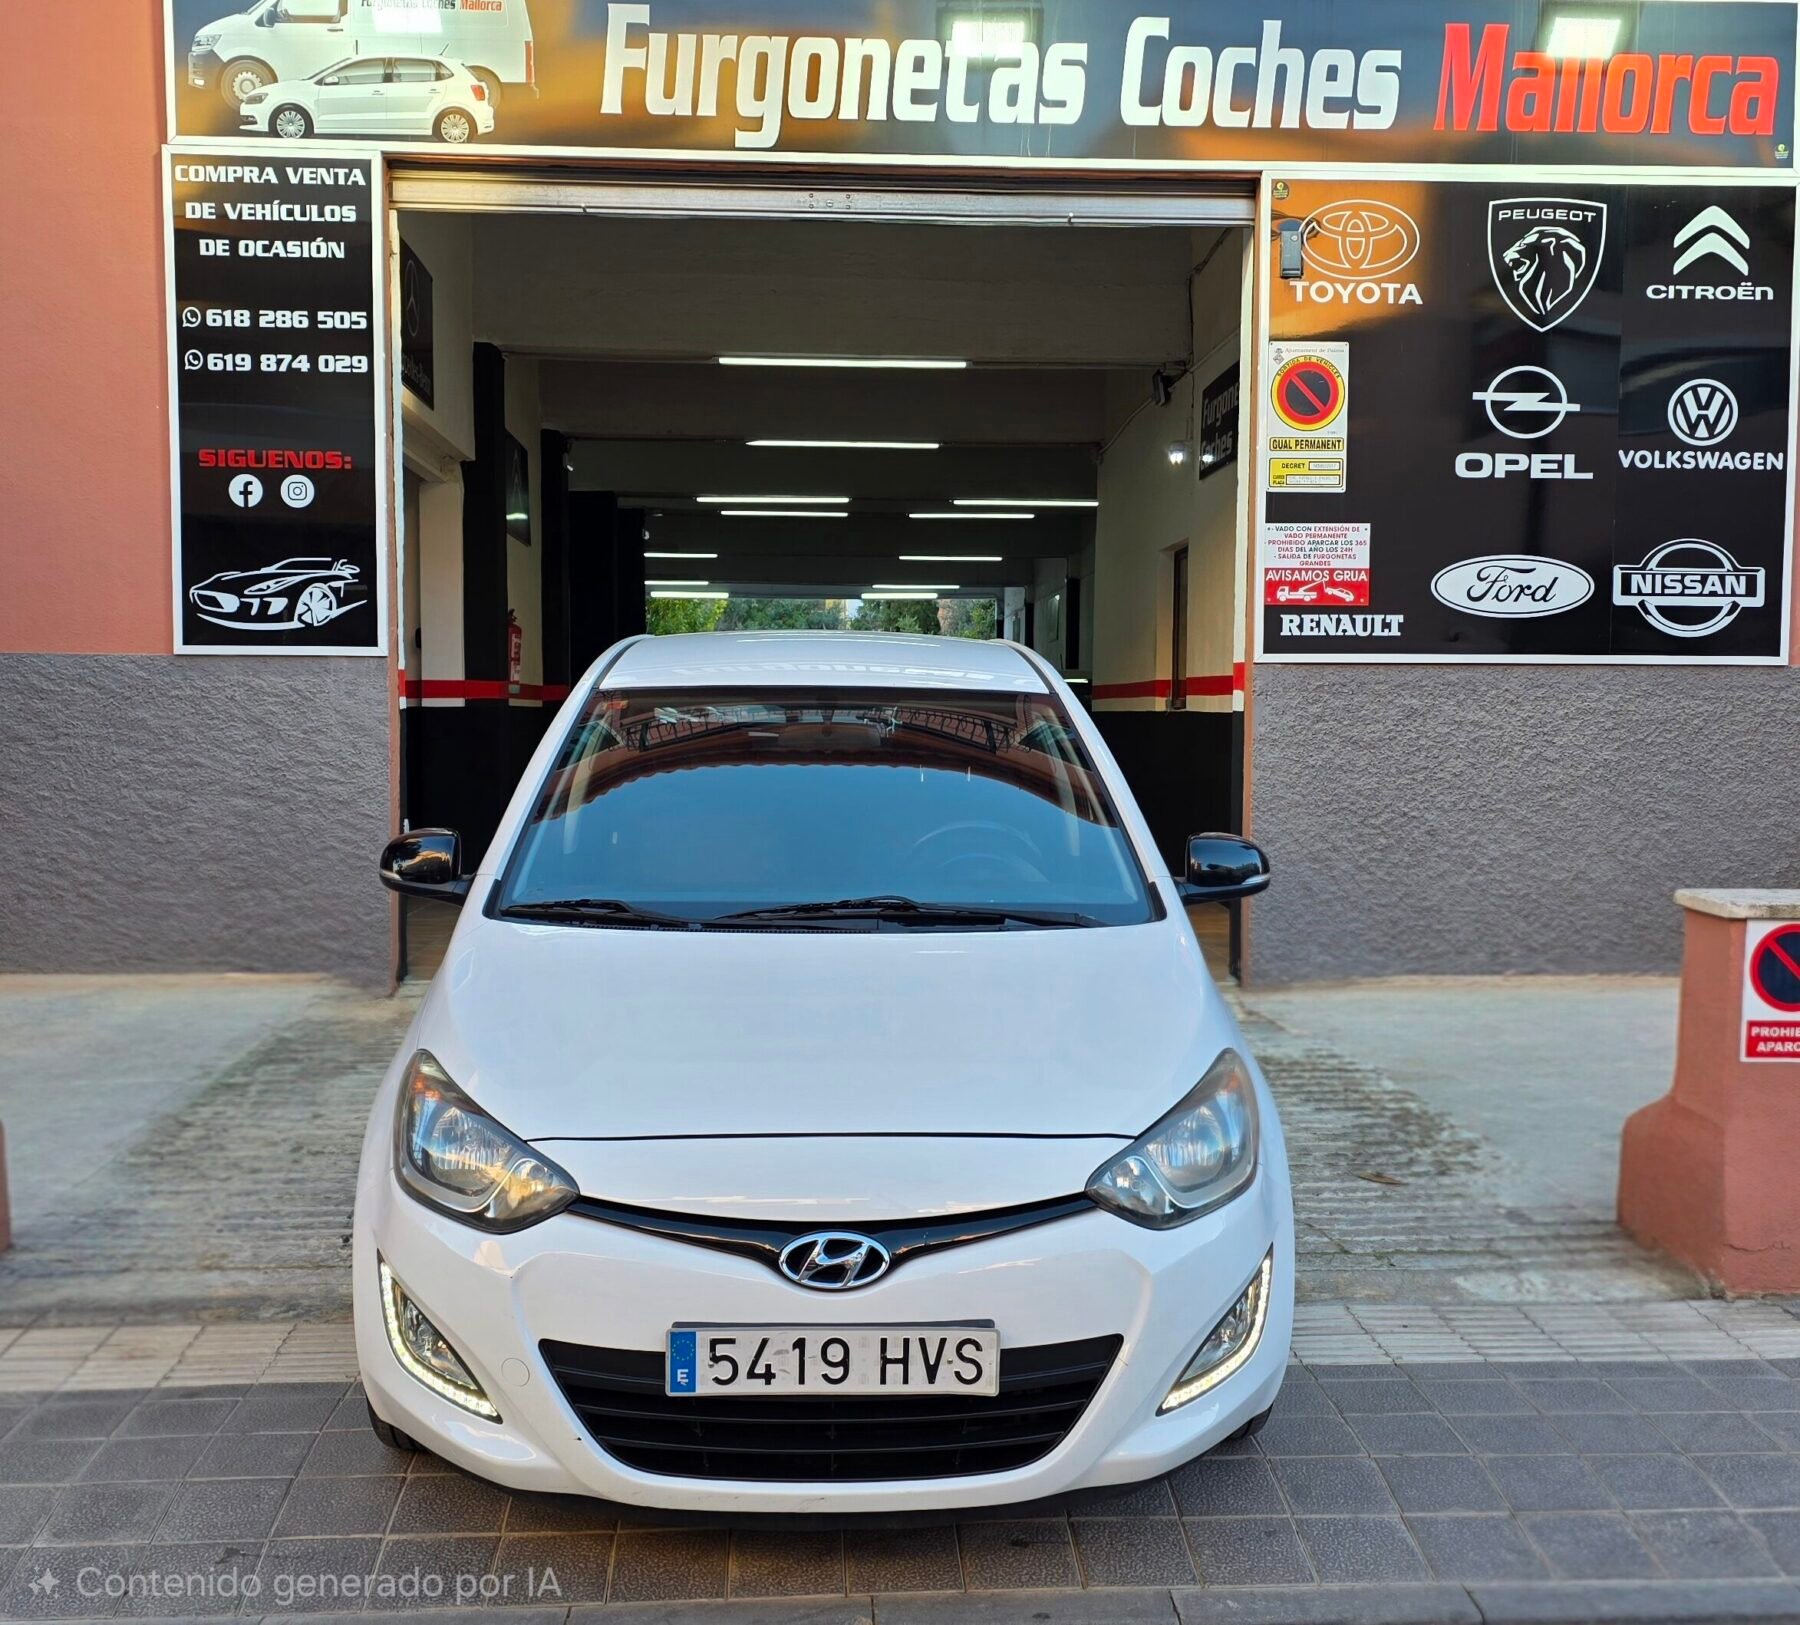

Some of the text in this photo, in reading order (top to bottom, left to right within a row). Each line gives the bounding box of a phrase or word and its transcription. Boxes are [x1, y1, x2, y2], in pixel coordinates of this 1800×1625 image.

[601, 3, 1780, 148] Furgonetas Coches Mallorca
[174, 165, 366, 186] COMPRA VENTA
[185, 200, 356, 222] DE VEHÍCULOS
[1499, 209, 1597, 223] PEUGEOT
[199, 238, 345, 258] DE OCASIÓN
[1290, 280, 1423, 305] TOYOTA
[206, 309, 367, 329] 618 286 505
[207, 353, 368, 373] 619 874 029
[1272, 439, 1342, 450] GUAL PERMANENT
[198, 448, 353, 470] SIGUENOS:
[1455, 453, 1594, 479] OPEL
[1618, 449, 1784, 470] VOLKSWAGEN
[1266, 570, 1367, 581] AVISAMOS GRUA
[1466, 564, 1557, 604] Ford
[1631, 573, 1746, 595] NISSAN
[1280, 614, 1404, 637] RENAULT
[677, 1337, 984, 1386] E 5419 HVS
